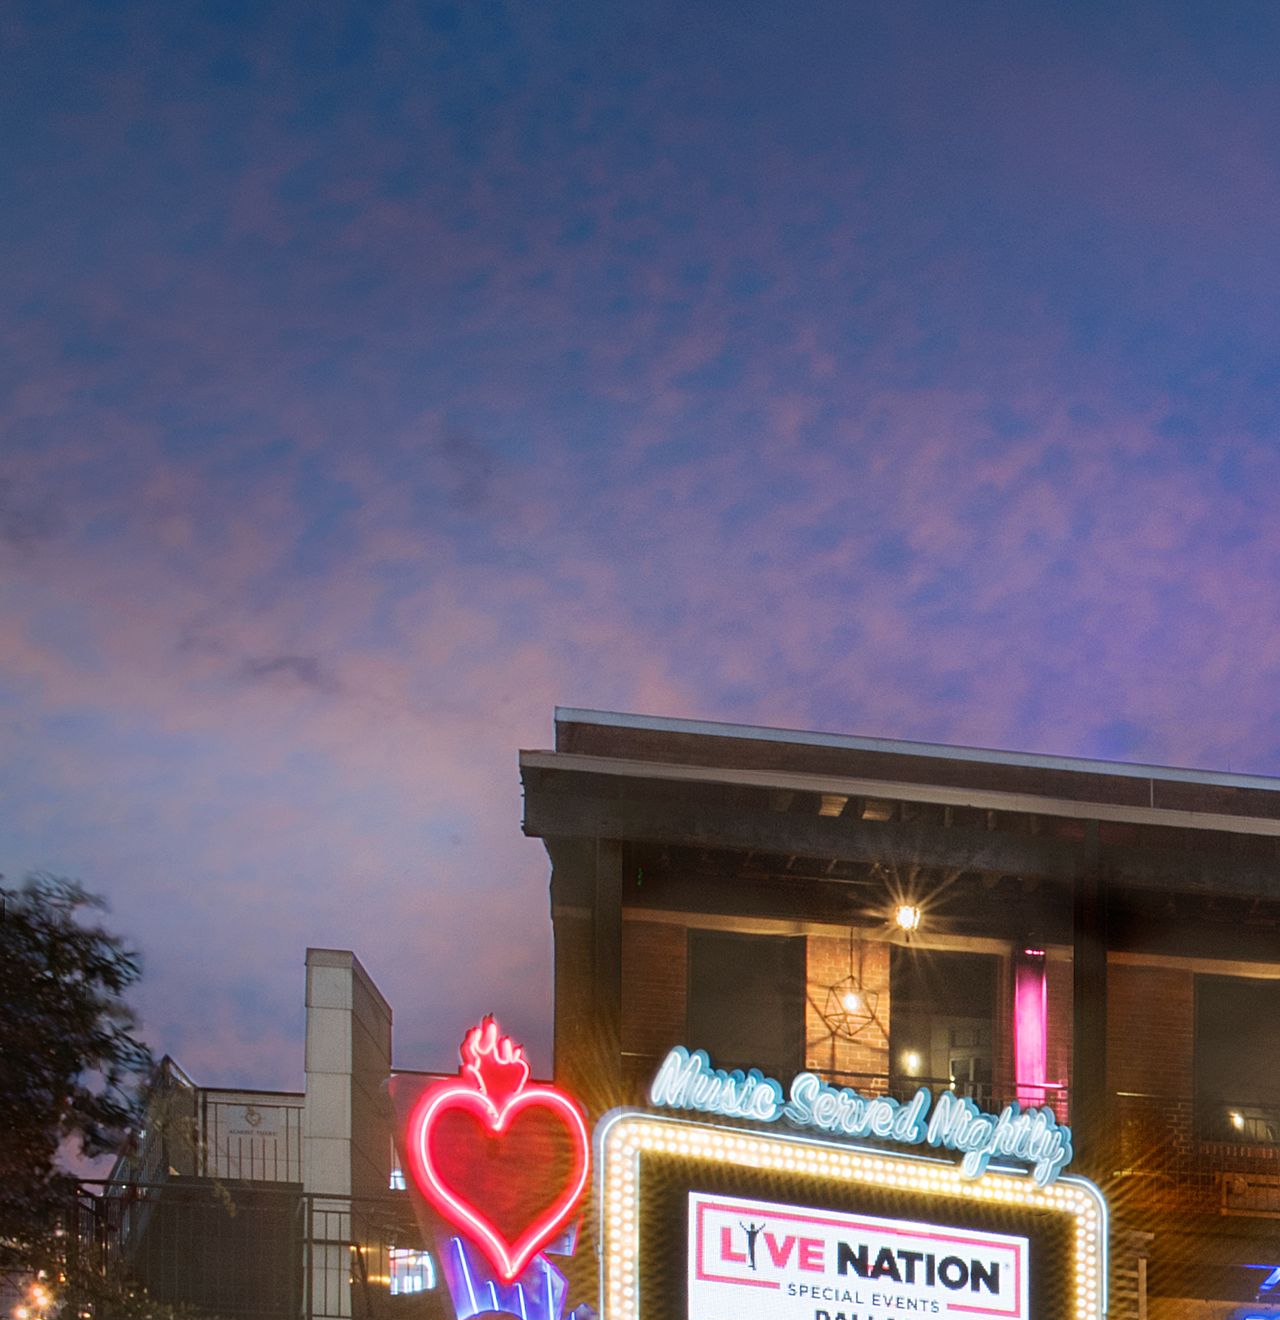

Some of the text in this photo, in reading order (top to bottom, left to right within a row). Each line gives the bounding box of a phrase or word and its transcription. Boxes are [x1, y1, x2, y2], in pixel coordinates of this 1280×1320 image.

[651, 1045, 1073, 1188] Music Served Nightly
[720, 1222, 1001, 1295] LIVE NATION
[787, 1282, 940, 1314] SPECIAL EVENTS
